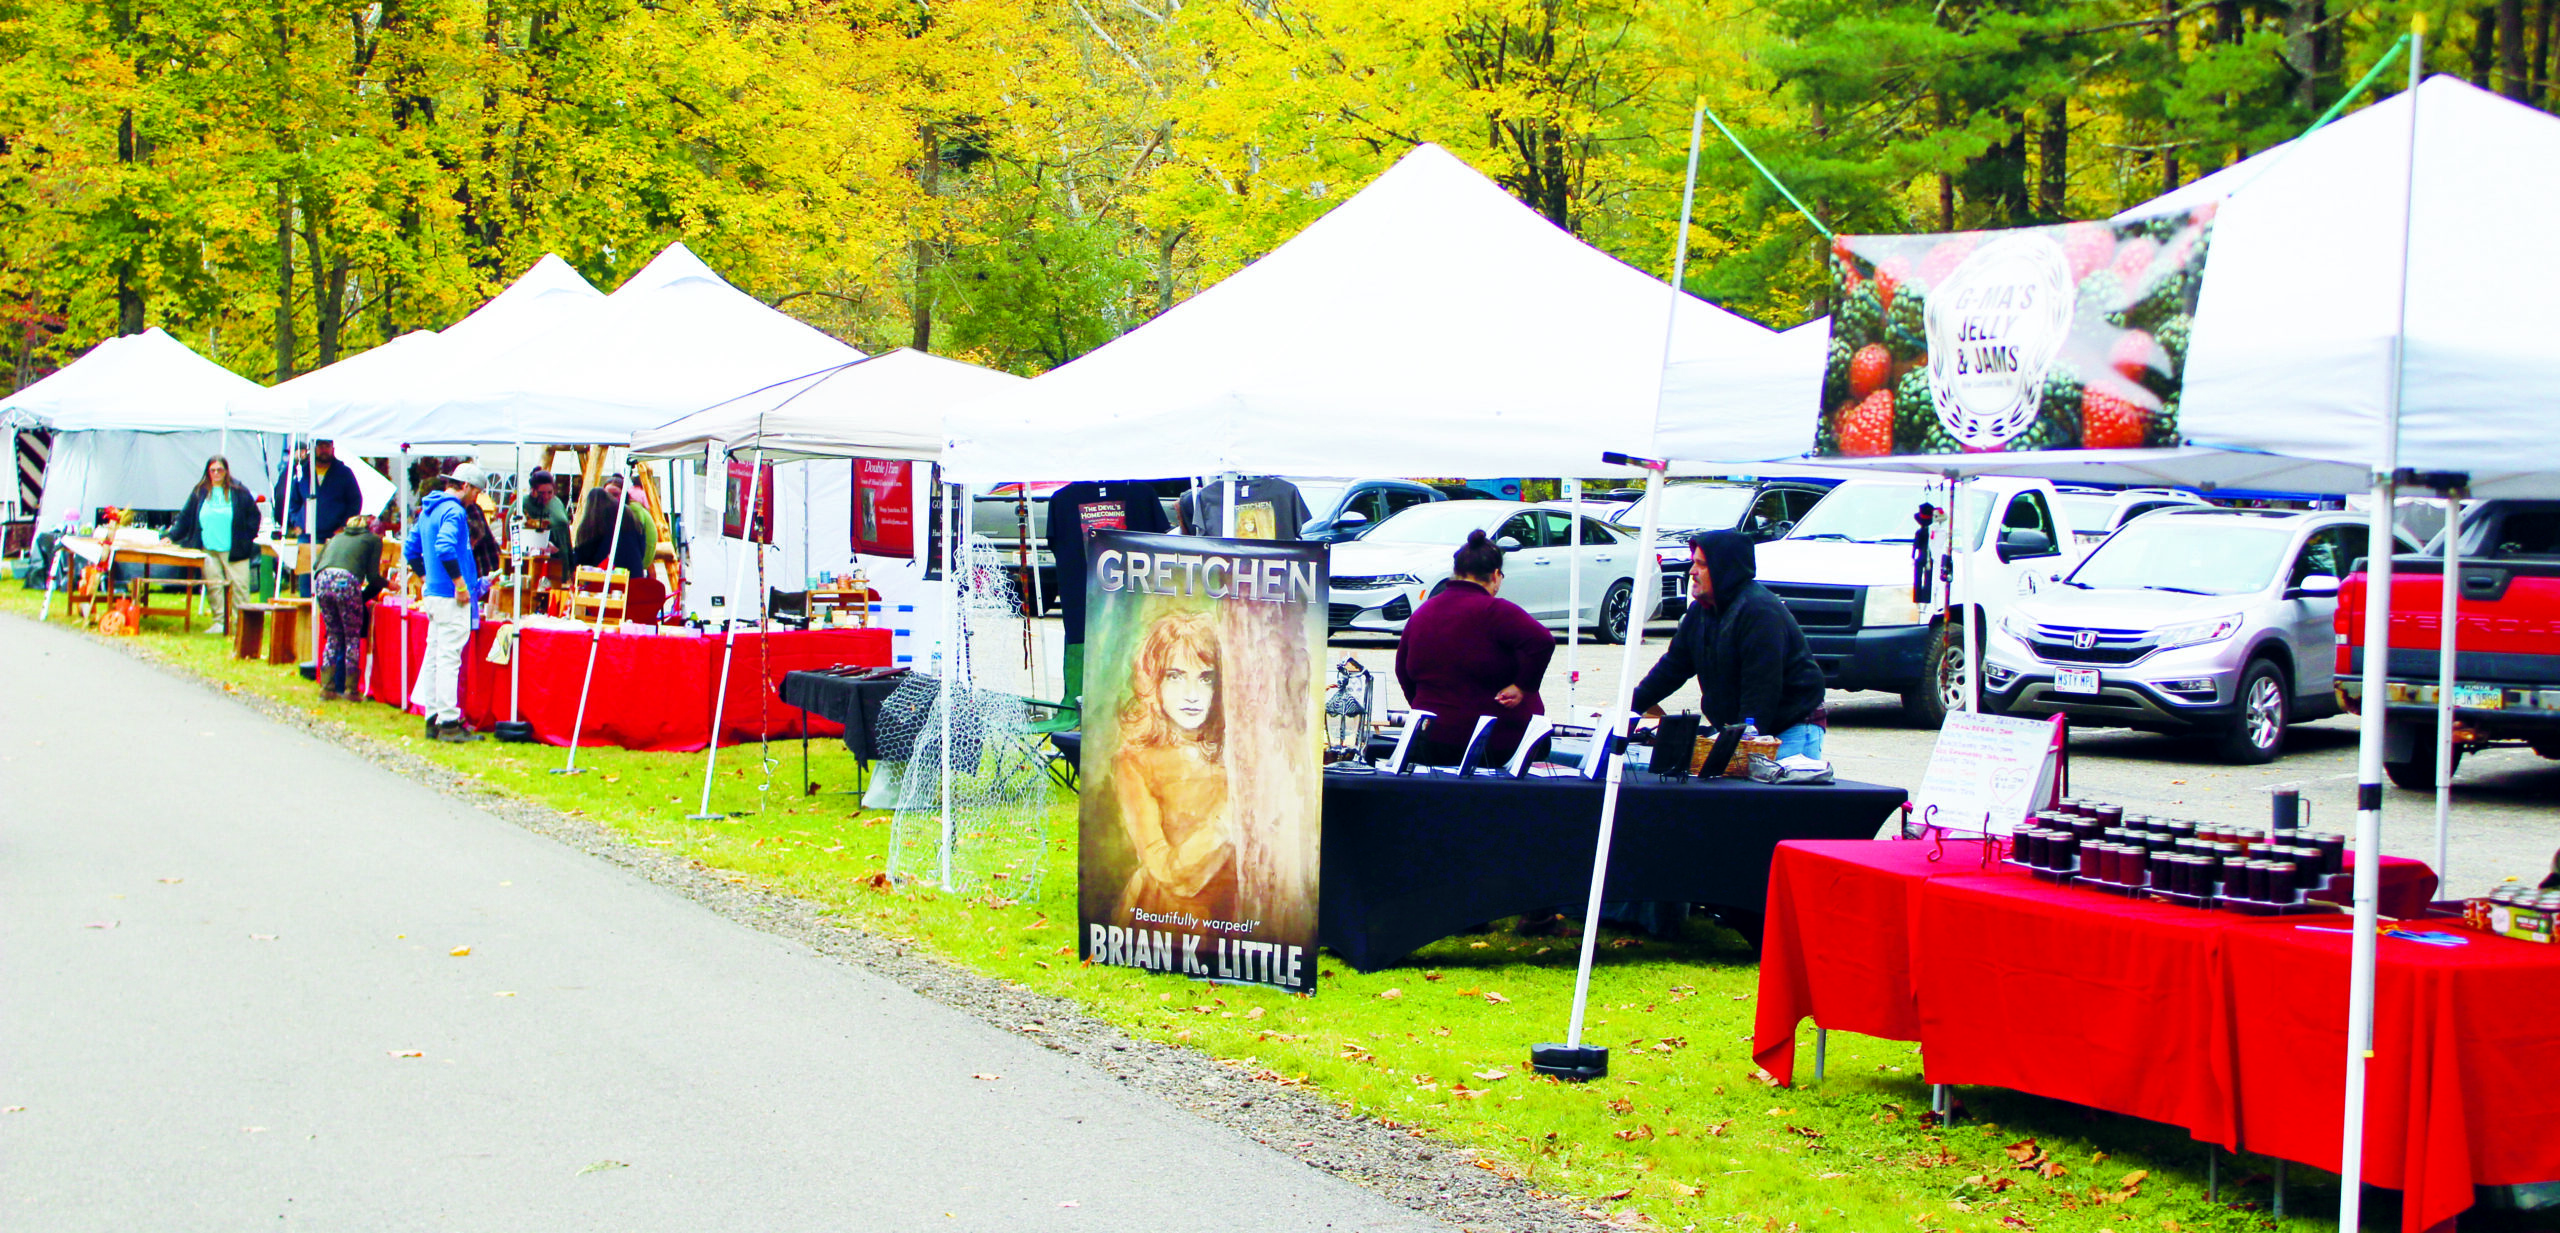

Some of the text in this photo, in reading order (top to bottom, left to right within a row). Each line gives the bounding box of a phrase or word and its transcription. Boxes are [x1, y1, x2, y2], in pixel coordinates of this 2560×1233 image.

[1955, 283, 2036, 310] G-MA'S
[1957, 314, 2019, 342] JELLY
[1957, 345, 2019, 375] & JAMS
[864, 460, 886, 475] Double
[1080, 510, 1126, 519] HOMECOMING
[1083, 503, 1122, 513] THE DEVIL'S
[1234, 501, 1272, 513] RETCHEN
[1096, 549, 1318, 604] GRETCHEN
[2057, 674, 2095, 688] MSTY MPL
[1090, 923, 1303, 987] BRIAN K. LITTLE
